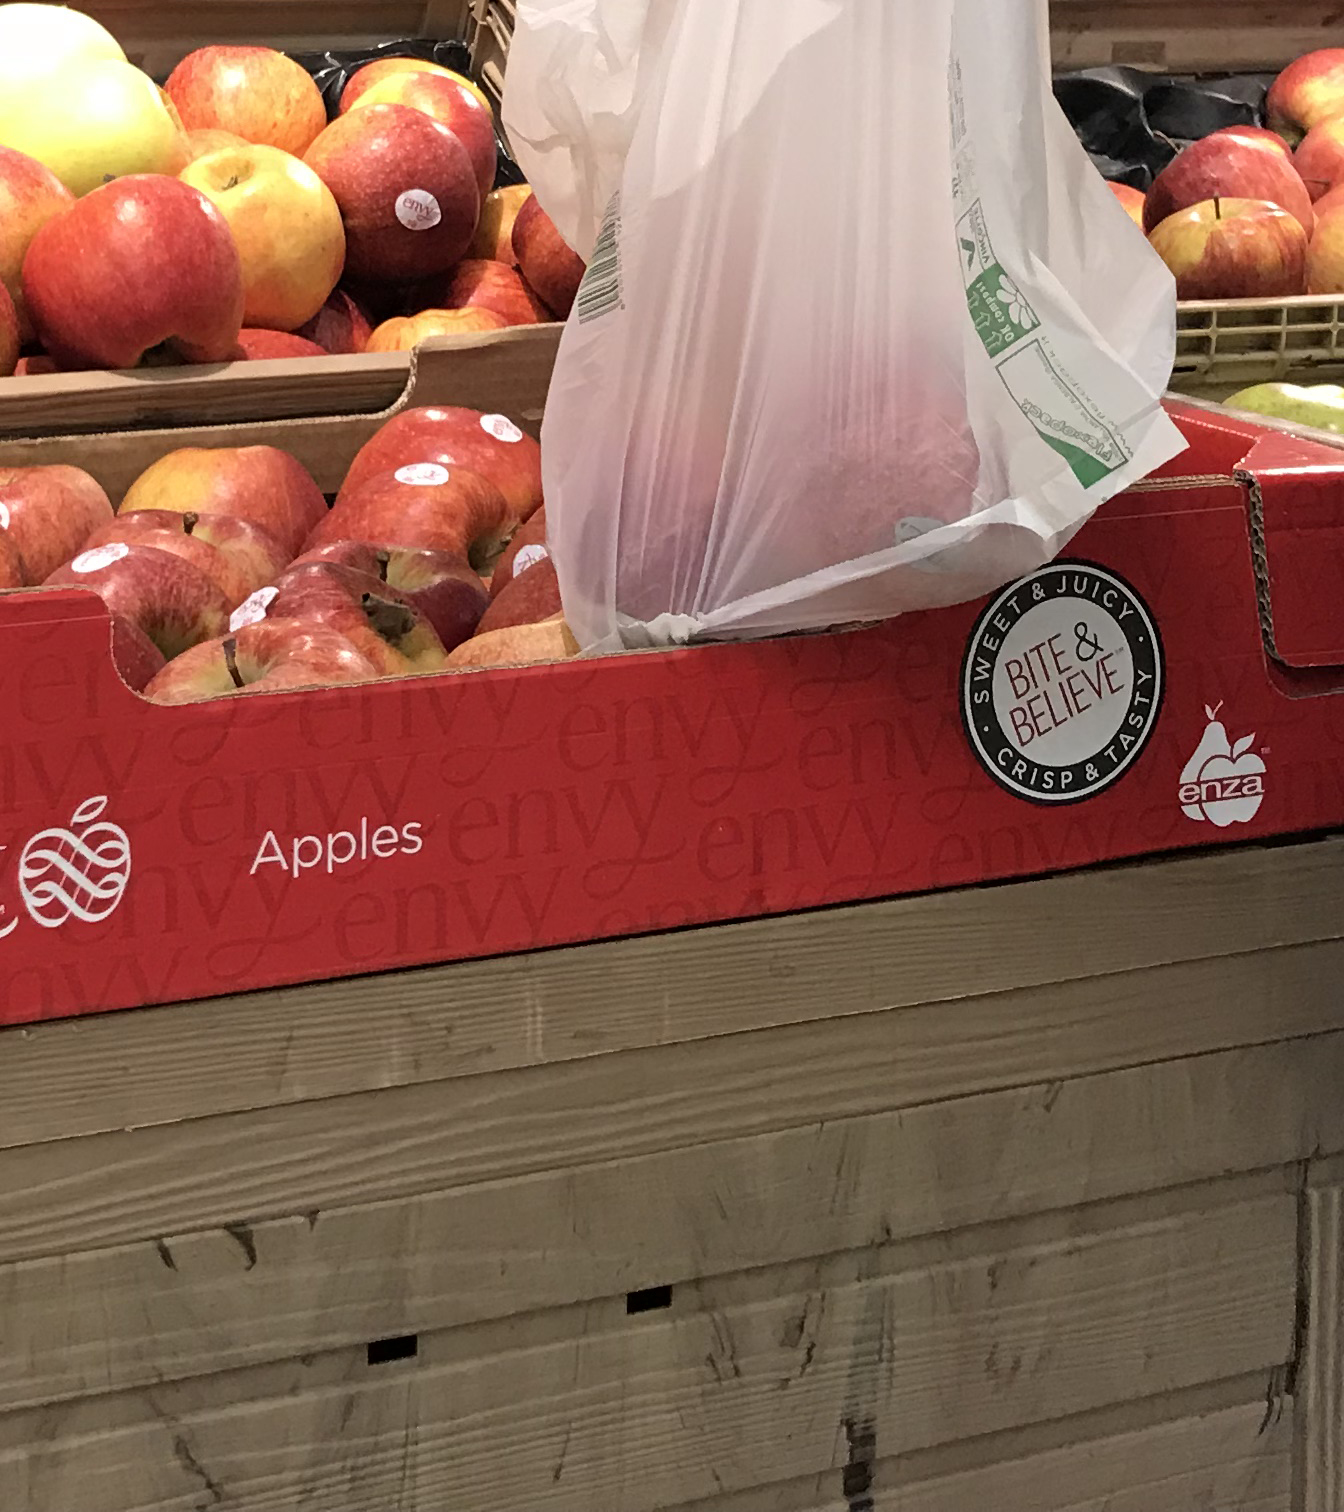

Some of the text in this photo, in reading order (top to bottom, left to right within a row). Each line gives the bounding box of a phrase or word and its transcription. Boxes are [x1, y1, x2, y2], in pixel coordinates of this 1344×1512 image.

[974, 596, 1023, 703] SWEET
[1056, 575, 1134, 620] JUICY
[1005, 633, 1072, 700] BITE
[997, 748, 1073, 789] CRISP
[1104, 670, 1152, 763] TASTY
[1009, 653, 1125, 747] BELIEVE
[1178, 775, 1265, 803] enza
[249, 816, 422, 878] Apples
